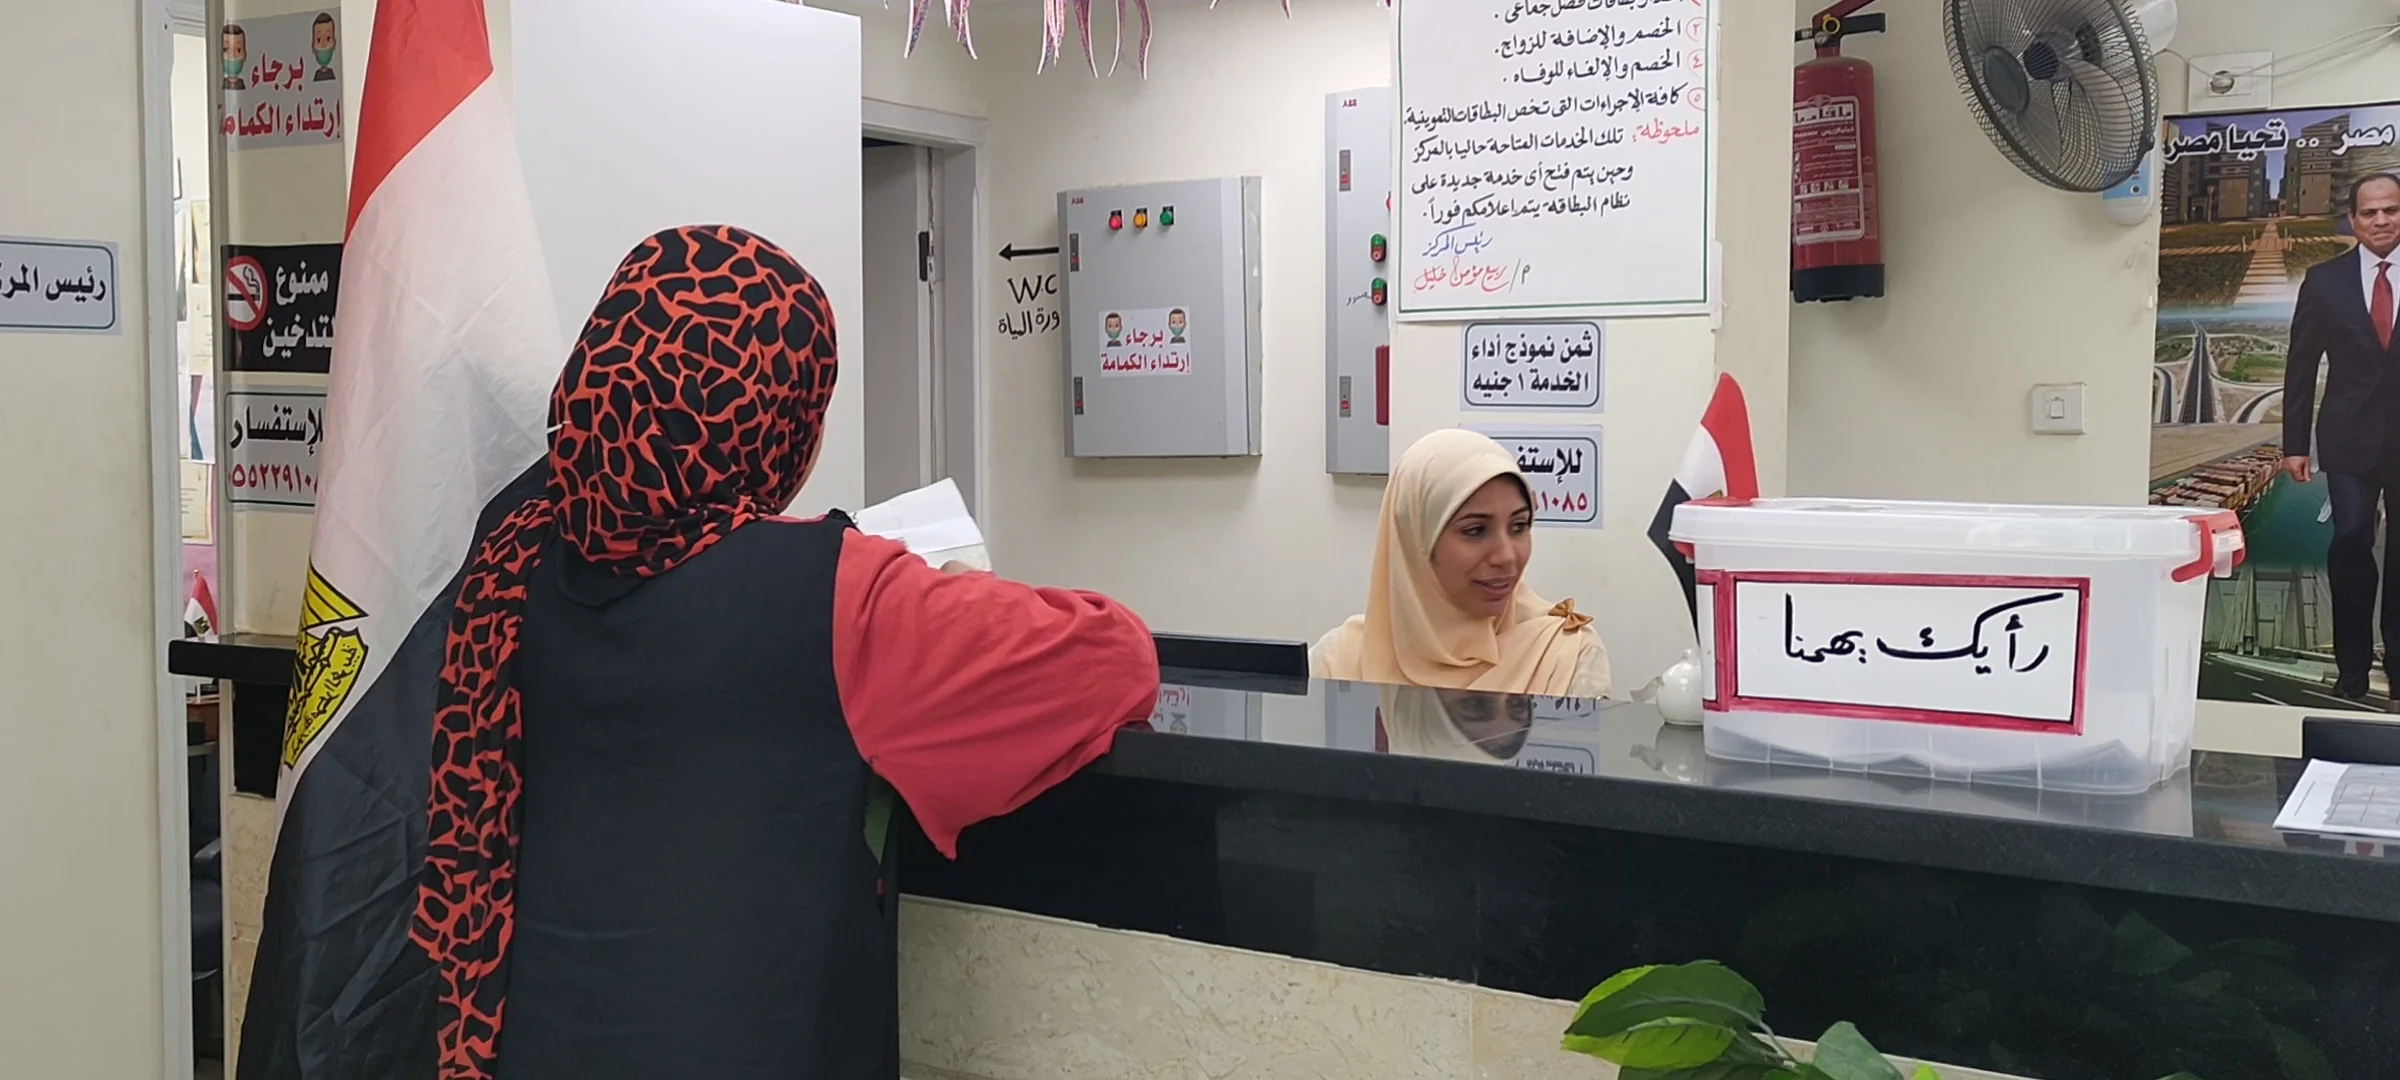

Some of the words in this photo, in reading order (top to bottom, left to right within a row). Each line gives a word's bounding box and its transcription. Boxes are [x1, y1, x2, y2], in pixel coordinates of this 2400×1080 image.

[1626, 16, 1681, 44] الخصم
[252, 53, 305, 91] برجاء
[1631, 48, 1680, 81] الخصم
[1645, 82, 1689, 106] كافة
[286, 97, 341, 139] إرتداء
[1453, 100, 1506, 123] البطاقات
[1507, 98, 1549, 122] تخص
[1413, 134, 1453, 163] بالمركز
[1455, 139, 1486, 159] حاليا
[1487, 132, 1538, 153] المتاحة
[1541, 126, 1594, 149] الخدمات
[1594, 127, 1624, 147] تلك
[2163, 131, 2222, 164] مصر
[2226, 118, 2290, 161] تحيا
[2331, 123, 2396, 156] مصر
[1441, 173, 1482, 192] جديدة
[1483, 168, 1524, 186] خدمة
[1543, 161, 1570, 191] فتح
[1571, 165, 1595, 191] يتم
[1597, 165, 1634, 185] وحين
[1542, 194, 1598, 217] البطاقة
[1600, 191, 1631, 216] نظام
[0, 263, 39, 300] المر
[45, 265, 106, 303] رئيس
[276, 261, 329, 306] ممنوع
[1035, 307, 1060, 333] ورة
[263, 313, 335, 358] لتدخين
[1126, 327, 1164, 348] برجاء
[1471, 333, 1501, 360] أداء
[1505, 333, 1555, 364] نموذج
[1559, 330, 1593, 363] ثمن
[1101, 353, 1147, 372] الكمامة
[1151, 351, 1190, 373] إرتداء
[1472, 370, 1512, 398] جنيه
[1529, 367, 1589, 392] الخدمة
[1516, 446, 1583, 485] للإستف
[1785, 593, 1869, 664] يهمنا
[1877, 593, 2063, 674] رأيك
